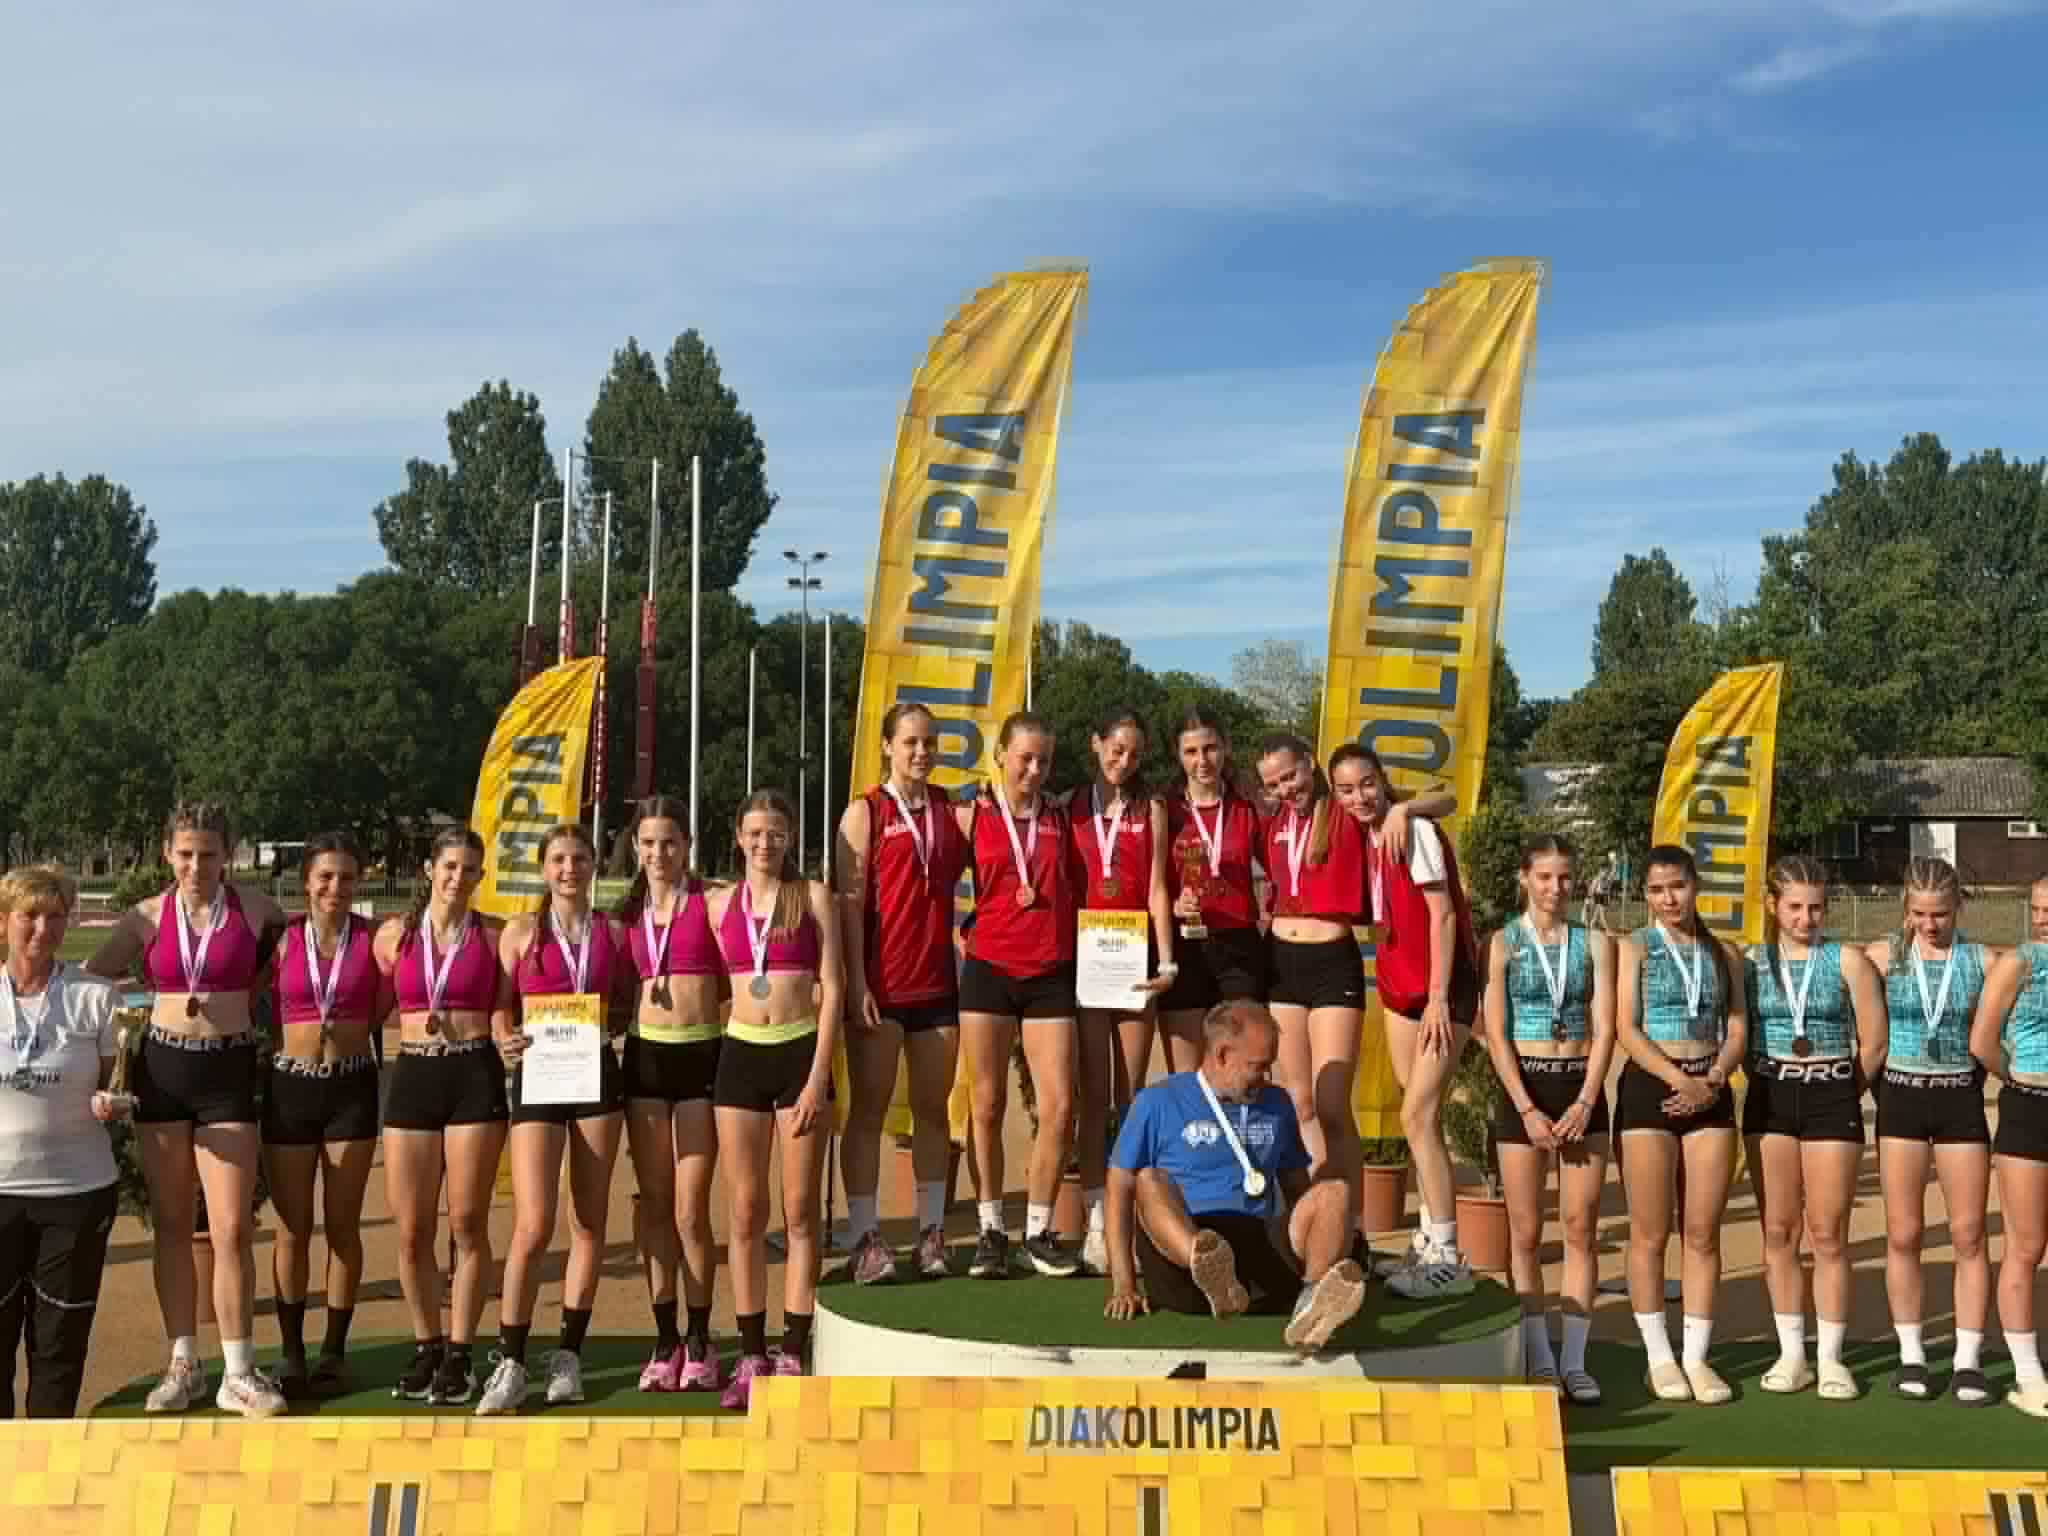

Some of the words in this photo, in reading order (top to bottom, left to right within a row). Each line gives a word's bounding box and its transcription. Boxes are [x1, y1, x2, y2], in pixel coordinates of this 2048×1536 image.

[1778, 1060, 1853, 1084] PRO
[1928, 1076, 1973, 1089] PRO
[1028, 1404, 1281, 1451] DIAKOLIMPIA
